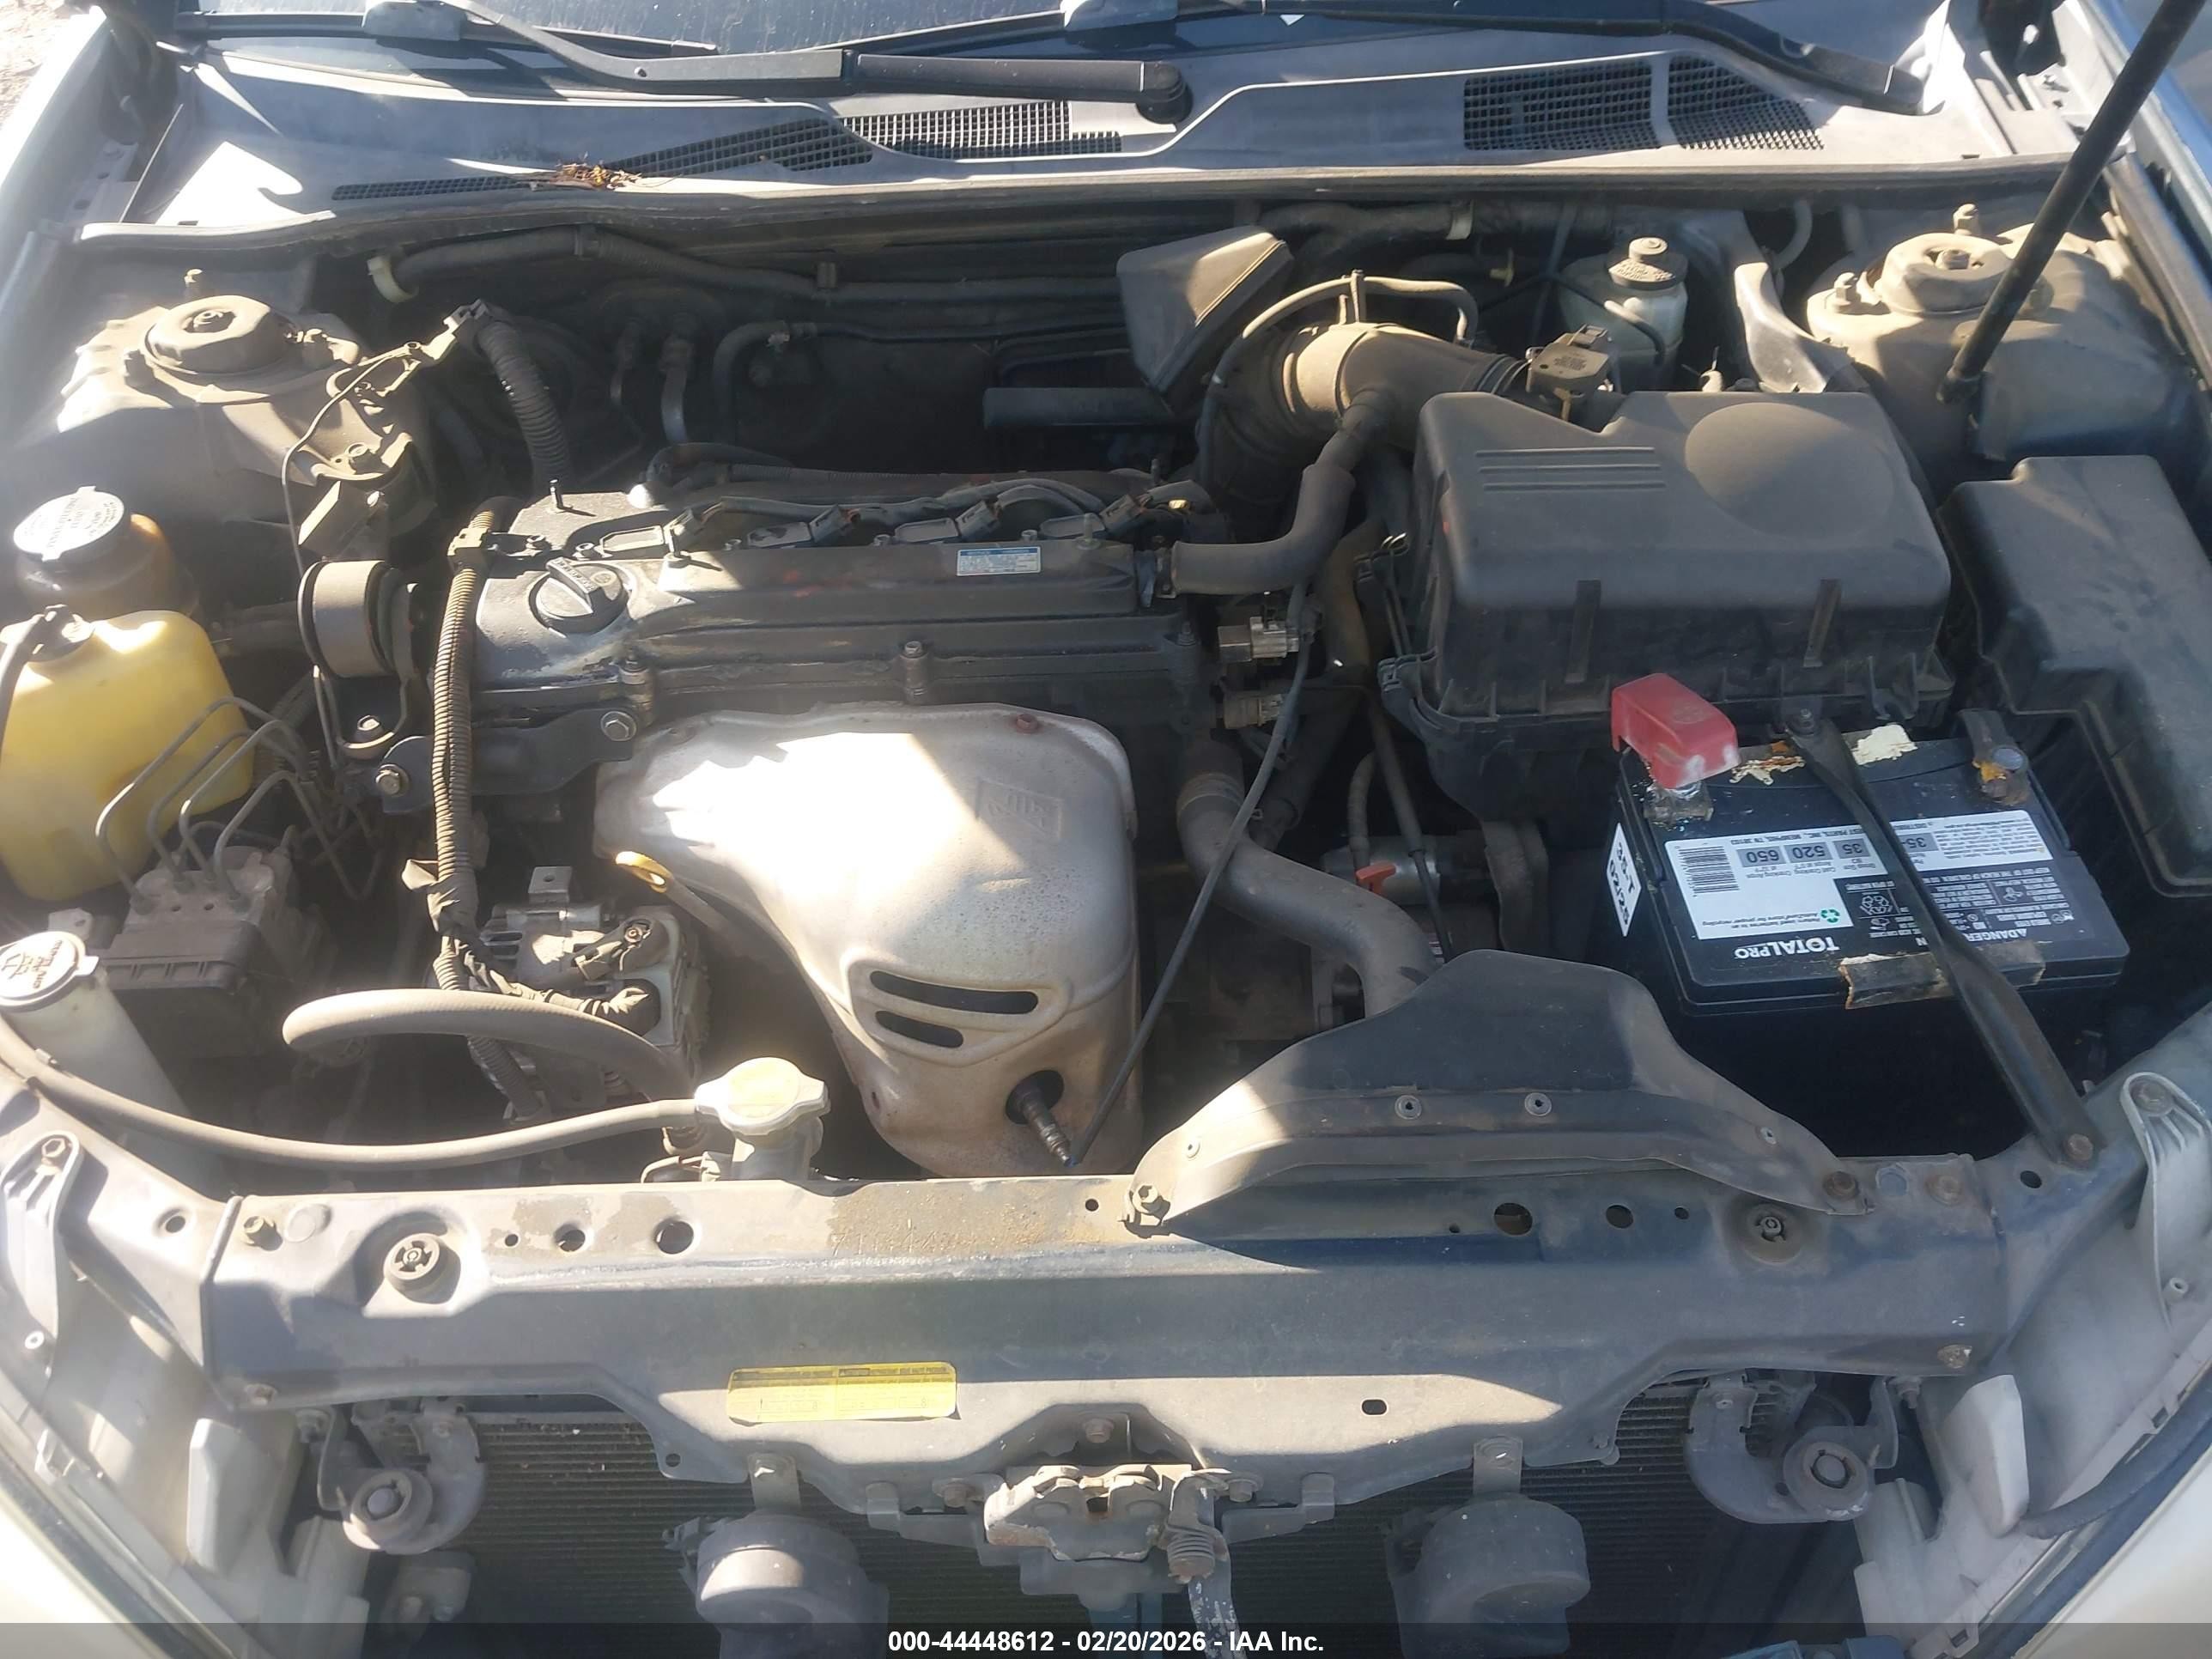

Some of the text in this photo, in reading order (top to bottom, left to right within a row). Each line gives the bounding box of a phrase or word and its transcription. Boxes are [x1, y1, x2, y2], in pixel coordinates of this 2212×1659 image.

[1840, 843, 1863, 854] 35
[1900, 836, 1926, 848] 35-
[1745, 849, 1780, 862] 650
[1790, 845, 1826, 858] 520
[1962, 928, 2019, 941] DANGER
[1734, 936, 1840, 959] TOTALPRO
